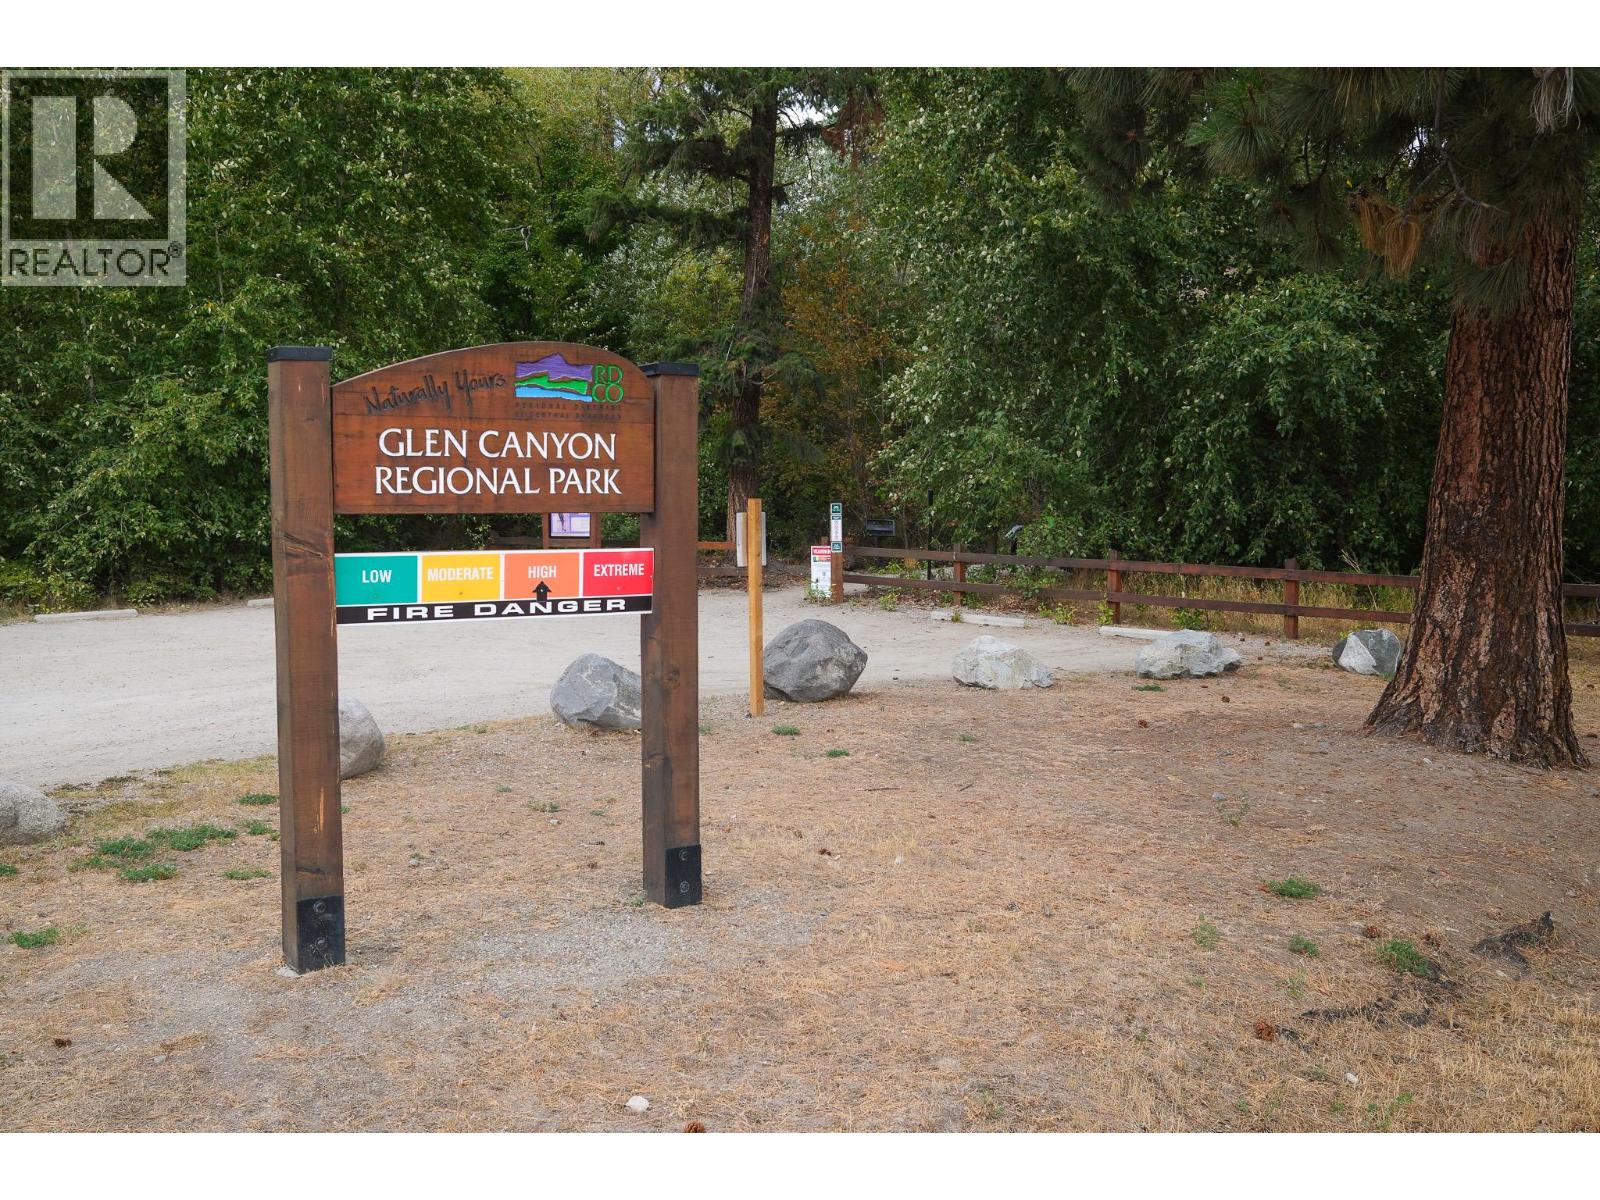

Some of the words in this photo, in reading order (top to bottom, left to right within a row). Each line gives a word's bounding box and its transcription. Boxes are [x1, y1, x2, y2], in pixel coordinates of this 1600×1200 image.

[594, 363, 623, 385] RD
[364, 373, 452, 416] Naturally
[454, 369, 506, 413] Yours
[591, 383, 624, 403] CO
[378, 428, 468, 459] GLEN
[478, 430, 616, 461] CANYON
[374, 466, 541, 495] REGIONAL
[549, 468, 623, 495] PARK
[362, 569, 393, 584] LOW
[427, 566, 495, 582] MODERATE
[528, 565, 557, 579] HIGH
[593, 563, 645, 578] EXTREME
[367, 604, 455, 621] FIRE
[473, 598, 627, 617] DANGER
